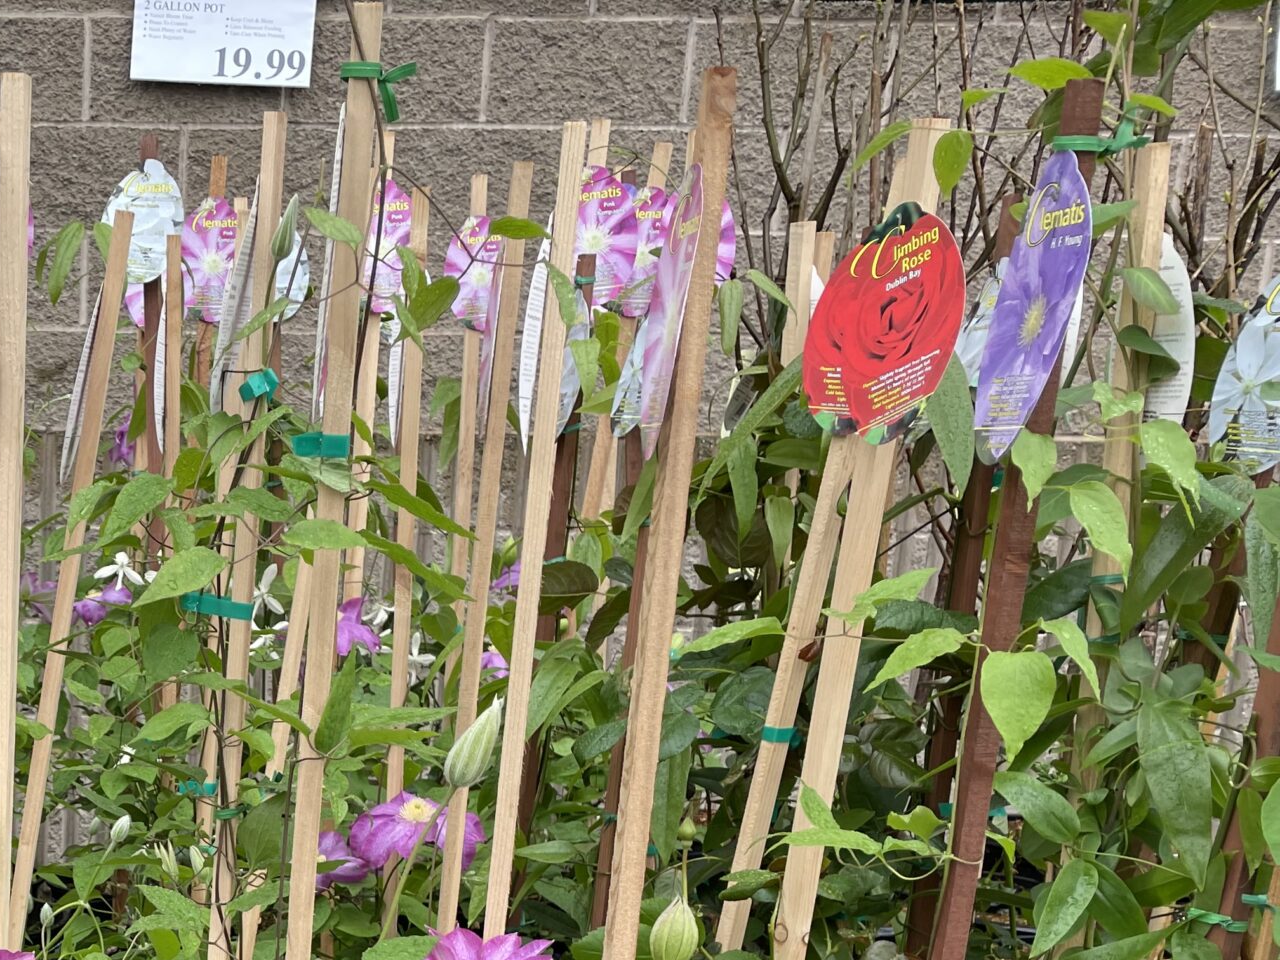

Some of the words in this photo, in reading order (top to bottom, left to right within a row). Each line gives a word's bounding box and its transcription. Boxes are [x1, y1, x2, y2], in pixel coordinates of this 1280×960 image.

[144, 0, 151, 10] 2
[153, 1, 200, 12] GALLON
[204, 3, 226, 13] POT
[212, 46, 306, 81] 19.99
[1026, 183, 1086, 248] Clematis
[871, 224, 940, 279] Climbing
[901, 249, 932, 273] Rose
[886, 275, 908, 292] Dublin
[908, 268, 922, 280] Bay
